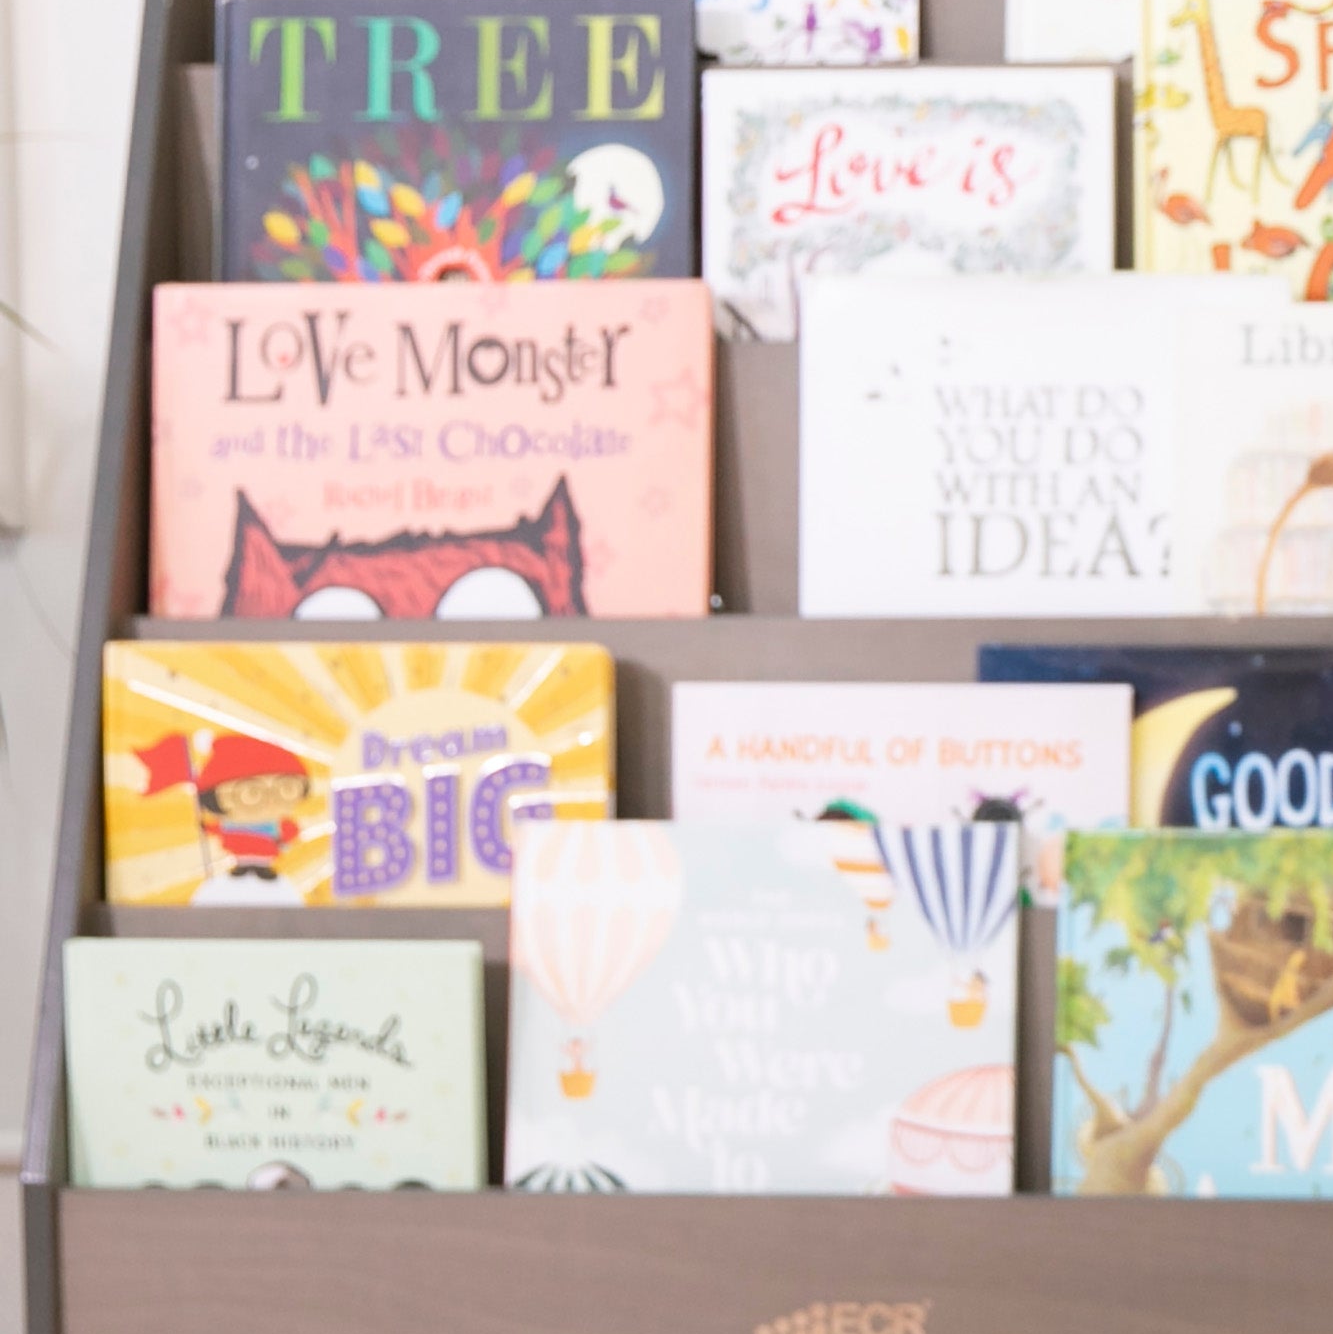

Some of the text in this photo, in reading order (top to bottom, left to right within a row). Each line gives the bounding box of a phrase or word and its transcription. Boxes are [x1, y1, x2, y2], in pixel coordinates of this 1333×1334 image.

[249, 14, 666, 123] TREE
[771, 123, 1033, 227] Love is
[396, 320, 632, 404] Monster
[934, 386, 1145, 420] WHAT DO
[210, 426, 266, 460] and
[276, 421, 330, 461] the
[935, 428, 1146, 465] YOU DO
[934, 472, 1142, 507] WITH AN
[935, 511, 1174, 579] IDEA?
[362, 724, 507, 770] Dream
[707, 736, 1084, 769] A HANDFUL OF BUTTONS
[332, 752, 553, 897] BIG
[672, 977, 779, 1034] You
[711, 1037, 866, 1092] Were
